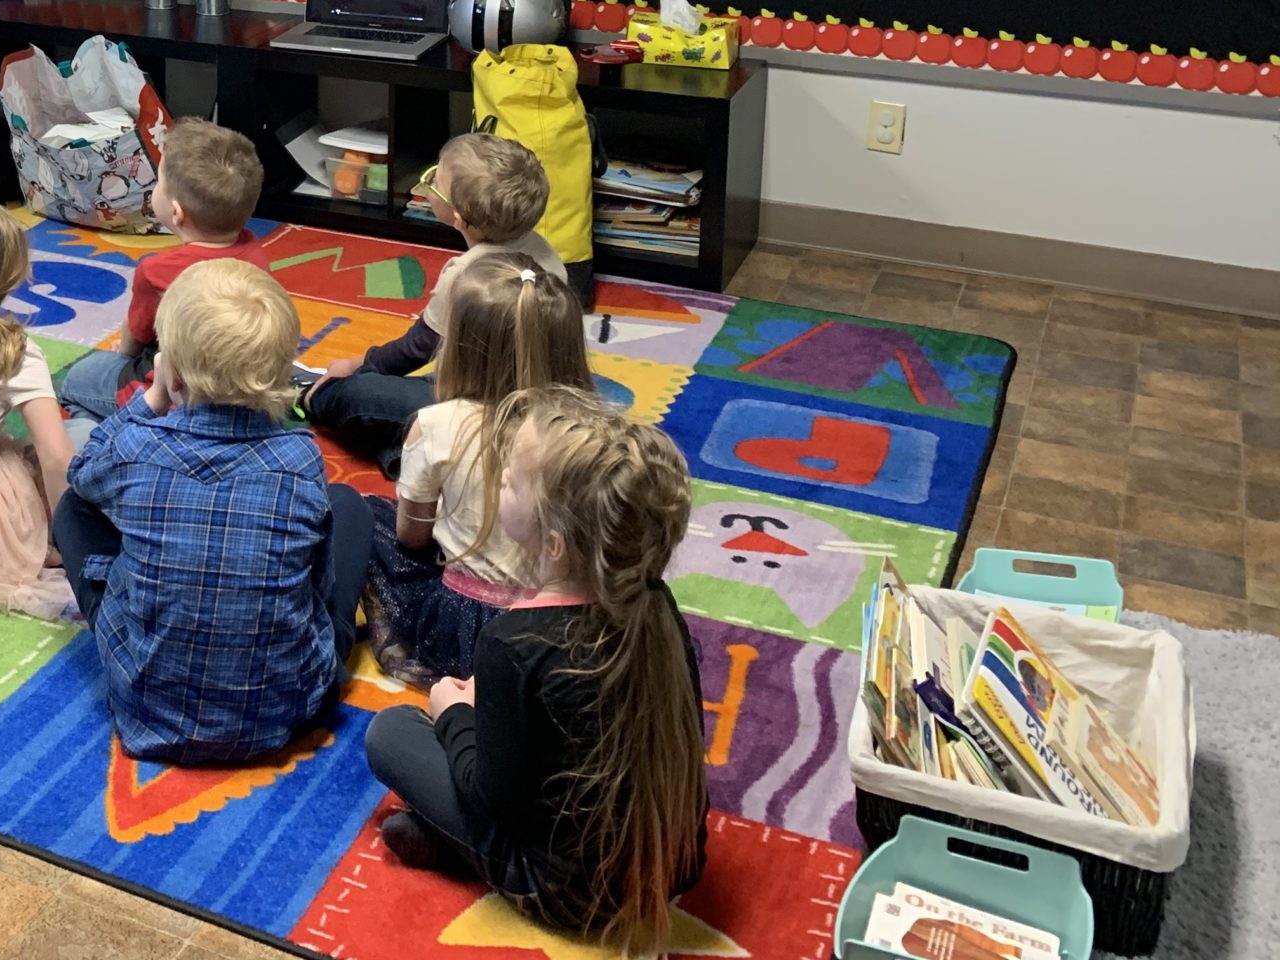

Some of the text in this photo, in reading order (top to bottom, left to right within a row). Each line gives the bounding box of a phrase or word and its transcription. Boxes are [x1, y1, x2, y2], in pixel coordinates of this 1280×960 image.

[904, 893, 1053, 954] On the Farm
